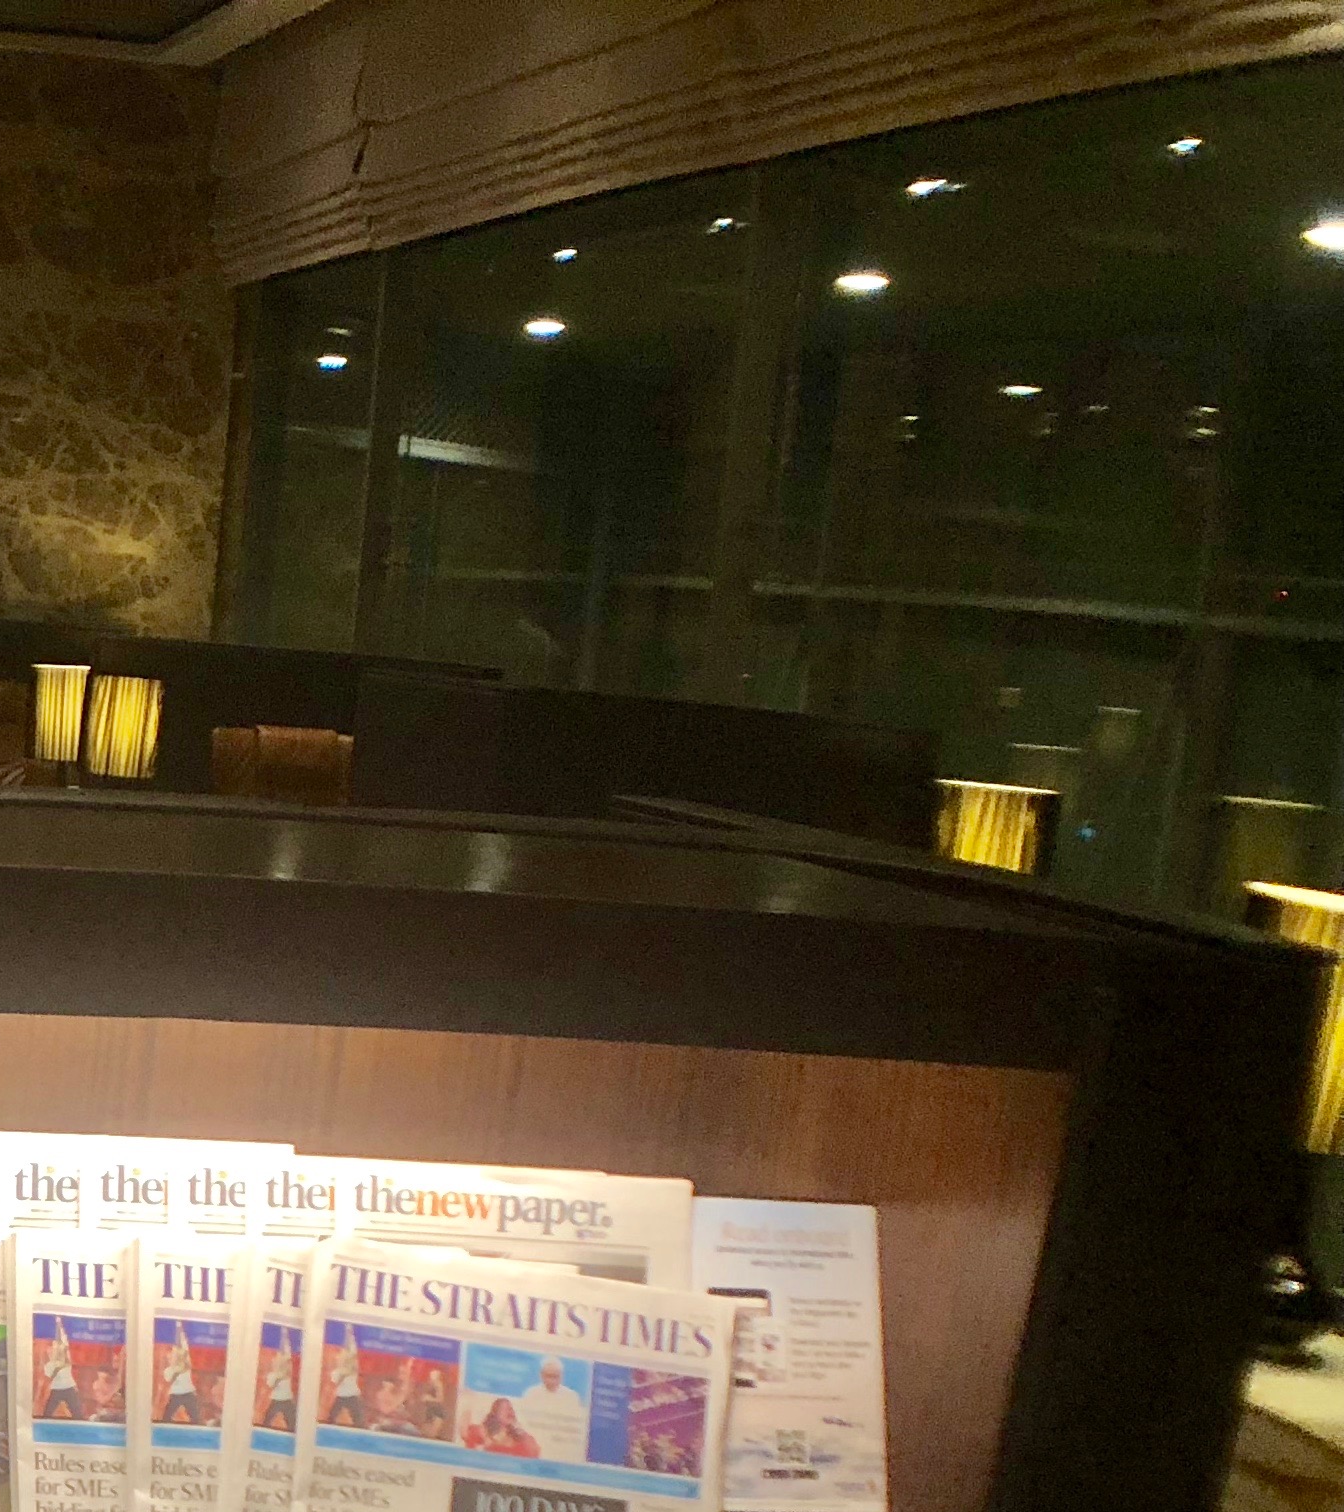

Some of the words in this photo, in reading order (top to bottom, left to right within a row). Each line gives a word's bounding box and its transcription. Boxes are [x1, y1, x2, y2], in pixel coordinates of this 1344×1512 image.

[188, 1167, 246, 1208] the
[32, 1257, 119, 1300] THE
[330, 1262, 414, 1312] THE
[419, 1279, 587, 1340] STRAITS
[596, 1305, 713, 1359] TIMES
[34, 1451, 86, 1475] Rules
[150, 1456, 203, 1478] Rules
[313, 1456, 361, 1481] Rules
[34, 1475, 60, 1495] for
[64, 1476, 118, 1498] SMEs
[150, 1481, 178, 1500] for
